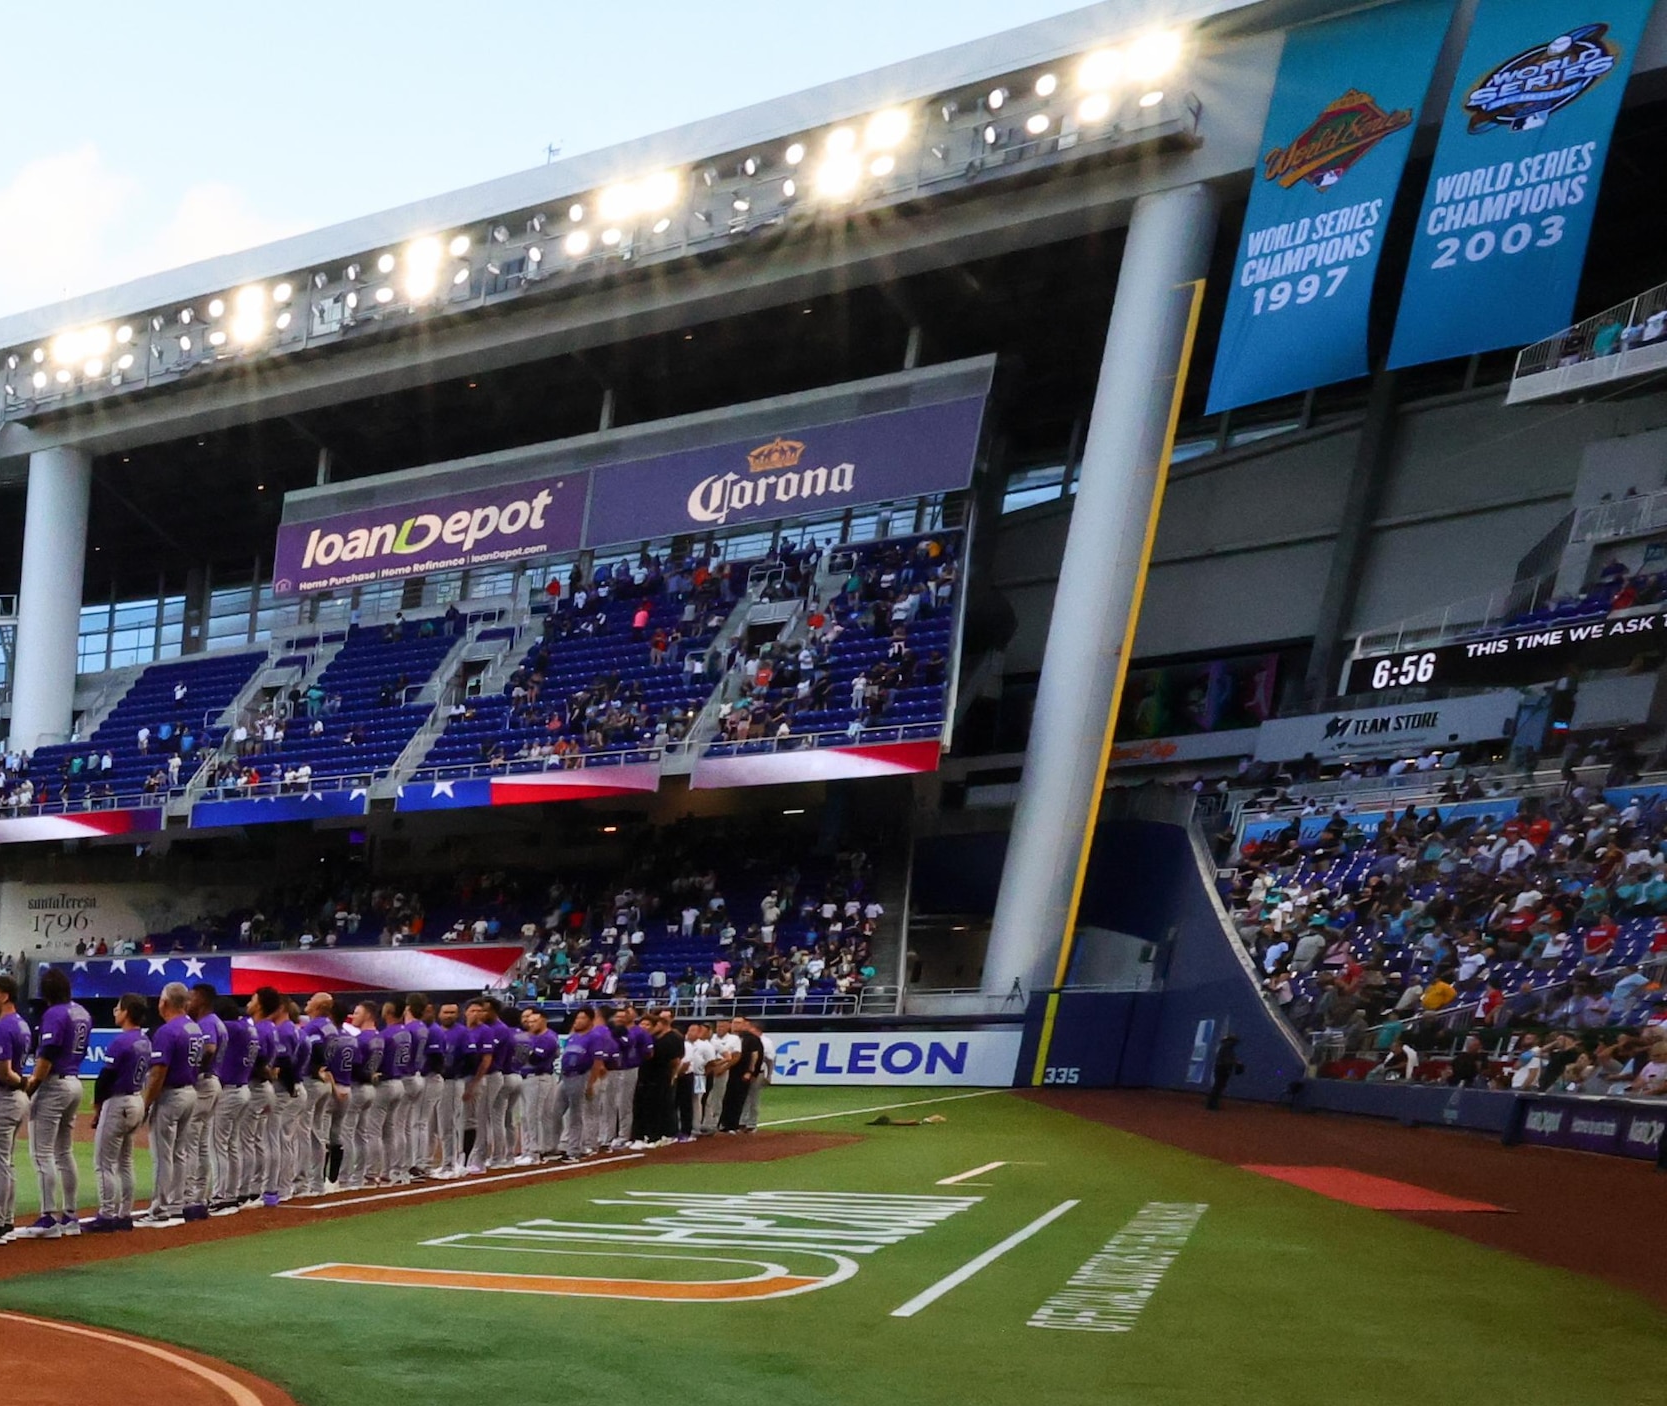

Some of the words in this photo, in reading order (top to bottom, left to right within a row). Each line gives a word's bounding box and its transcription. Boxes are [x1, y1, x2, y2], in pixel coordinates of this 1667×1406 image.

[1435, 160, 1514, 205] WORLD
[1515, 142, 1596, 188] SERIES
[1247, 217, 1314, 257] WORLD
[1314, 198, 1383, 240] SERIES
[1426, 174, 1588, 236] CHAMPIONS
[1240, 229, 1374, 288] CHAMPIONS
[1430, 215, 1566, 270] 2003
[1252, 265, 1349, 316] 1997
[687, 461, 856, 526] Corona
[301, 489, 554, 570] loanDepot
[299, 579, 328, 592] Home
[329, 570, 376, 587] Purchase
[381, 564, 412, 579] Home
[413, 556, 465, 574] Refinance
[471, 544, 547, 564] loanDepot.com
[1466, 640, 1509, 659] THIS
[1515, 629, 1563, 651] TIME
[1569, 623, 1605, 642] WE
[1608, 615, 1654, 637] ASK
[1371, 652, 1437, 690] 6:56
[1353, 716, 1392, 737] TEAM
[1392, 711, 1439, 732] STORE
[33, 911, 90, 939] 1796
[814, 1041, 968, 1075] LEON
[1044, 1066, 1080, 1085] 335
